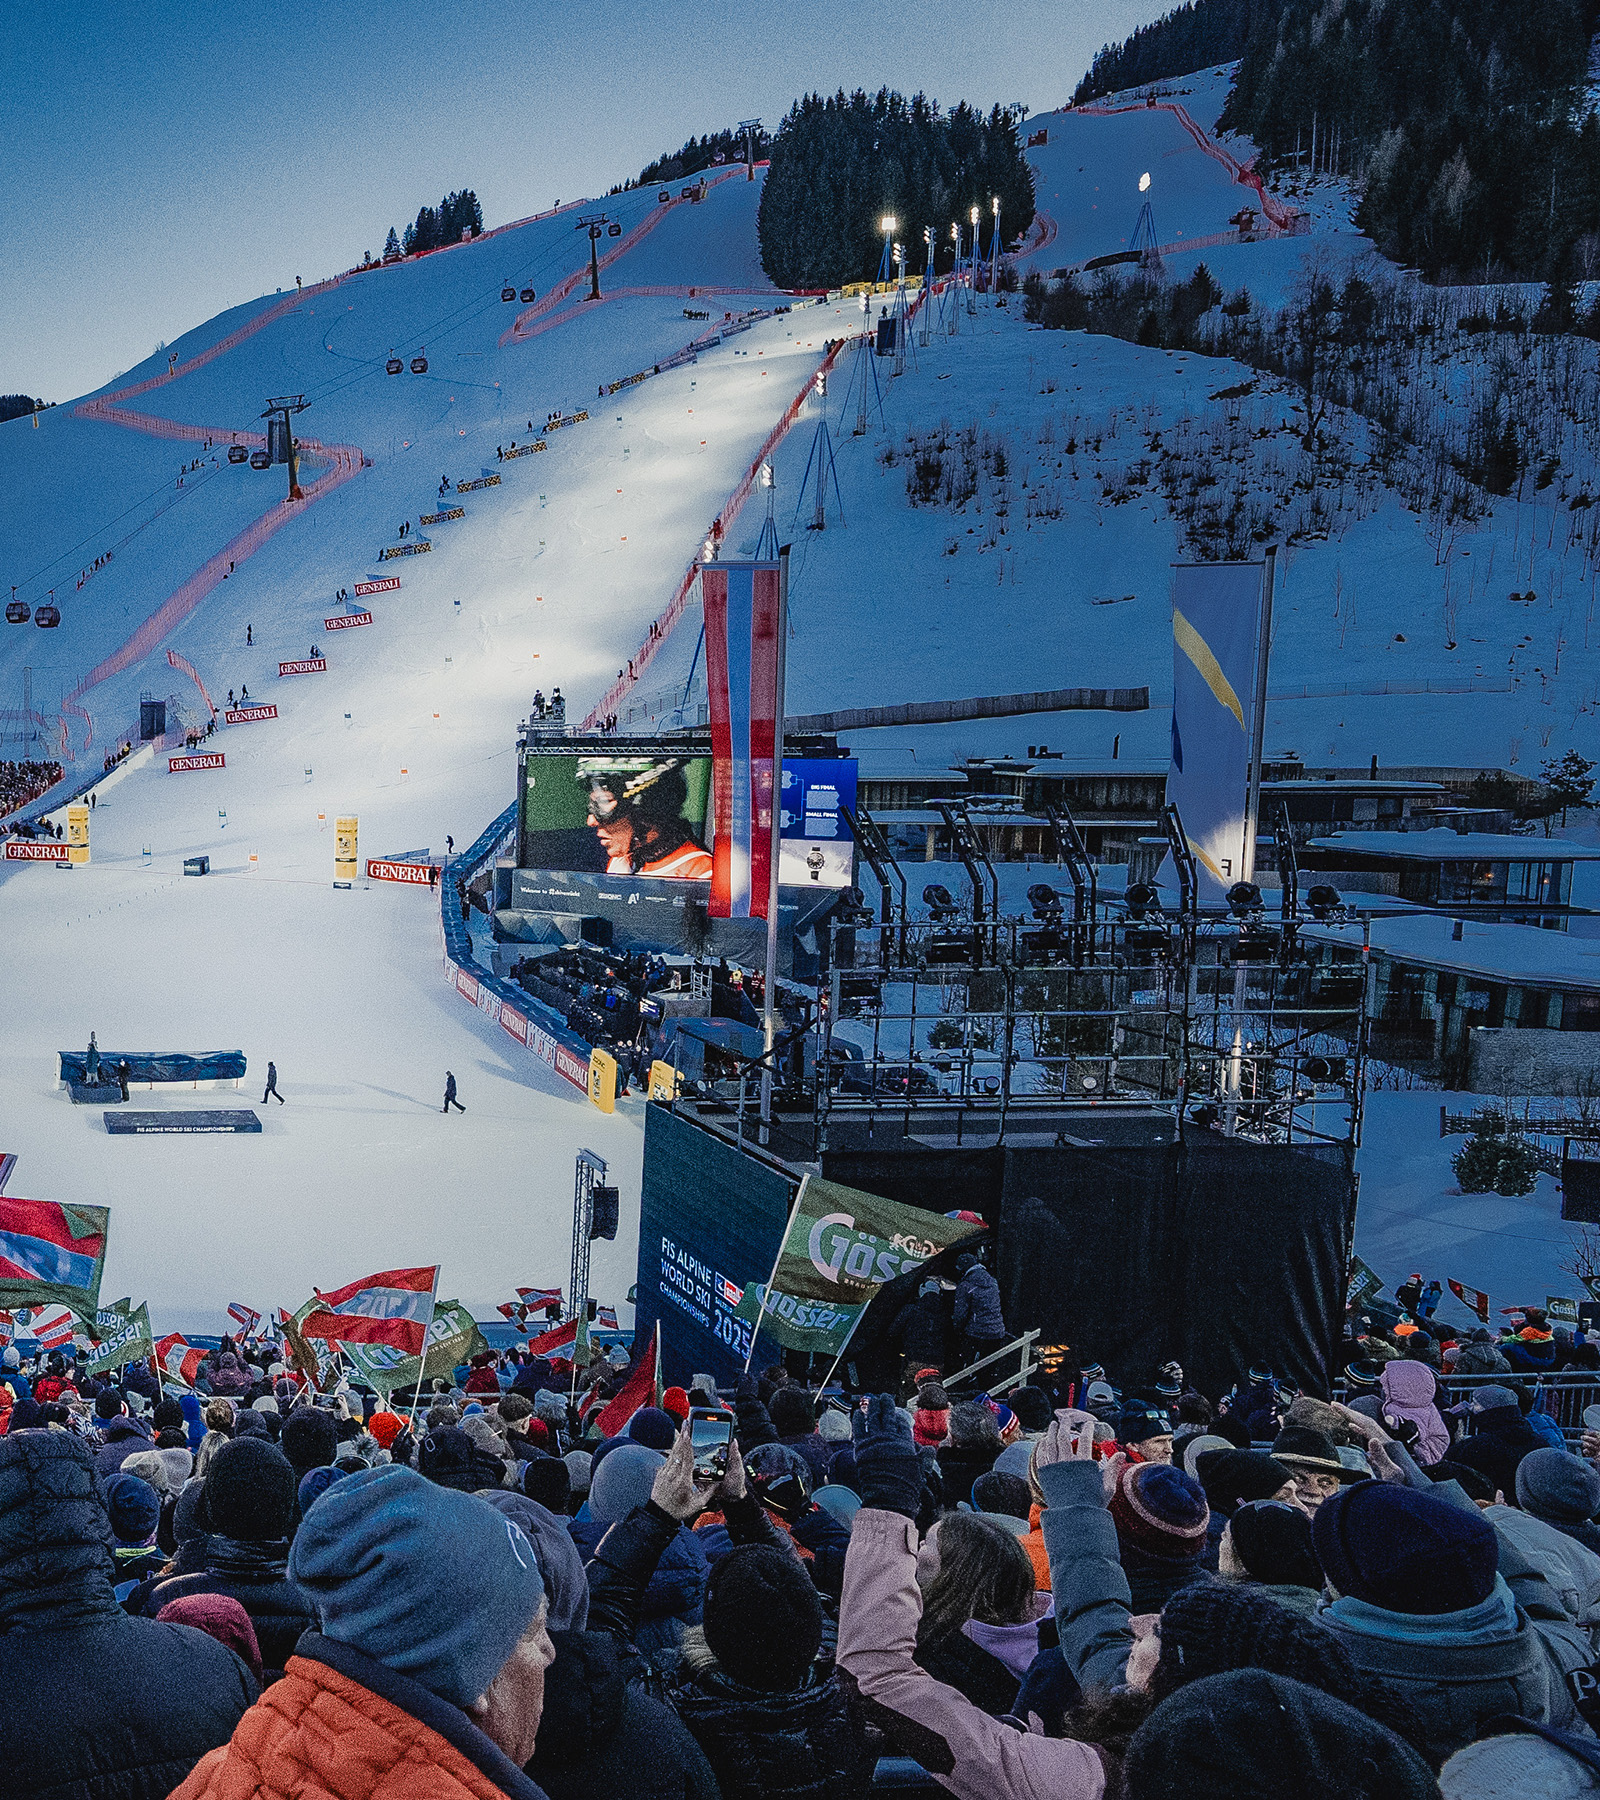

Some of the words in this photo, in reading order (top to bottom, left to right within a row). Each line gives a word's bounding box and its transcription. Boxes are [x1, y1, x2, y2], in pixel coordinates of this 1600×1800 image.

[356, 578, 400, 596] GENERALI
[325, 613, 372, 629] GENERALI
[280, 660, 325, 675] GENERALI
[227, 706, 277, 723] GENERALI
[170, 755, 224, 772] GENERALI
[8, 844, 69, 860] GENERALI
[627, 892, 640, 905] A1
[501, 1007, 527, 1040] GENERALI
[556, 1050, 588, 1090] GENERALI
[661, 1236, 676, 1260] FIS
[677, 1248, 712, 1288] ALPINE
[660, 1257, 694, 1296] WORLD
[695, 1284, 711, 1310] SKI
[659, 1281, 710, 1328] CHAMPIONSHIPS
[713, 1308, 752, 1360] 2025
[1569, 1670, 1600, 1702] P
